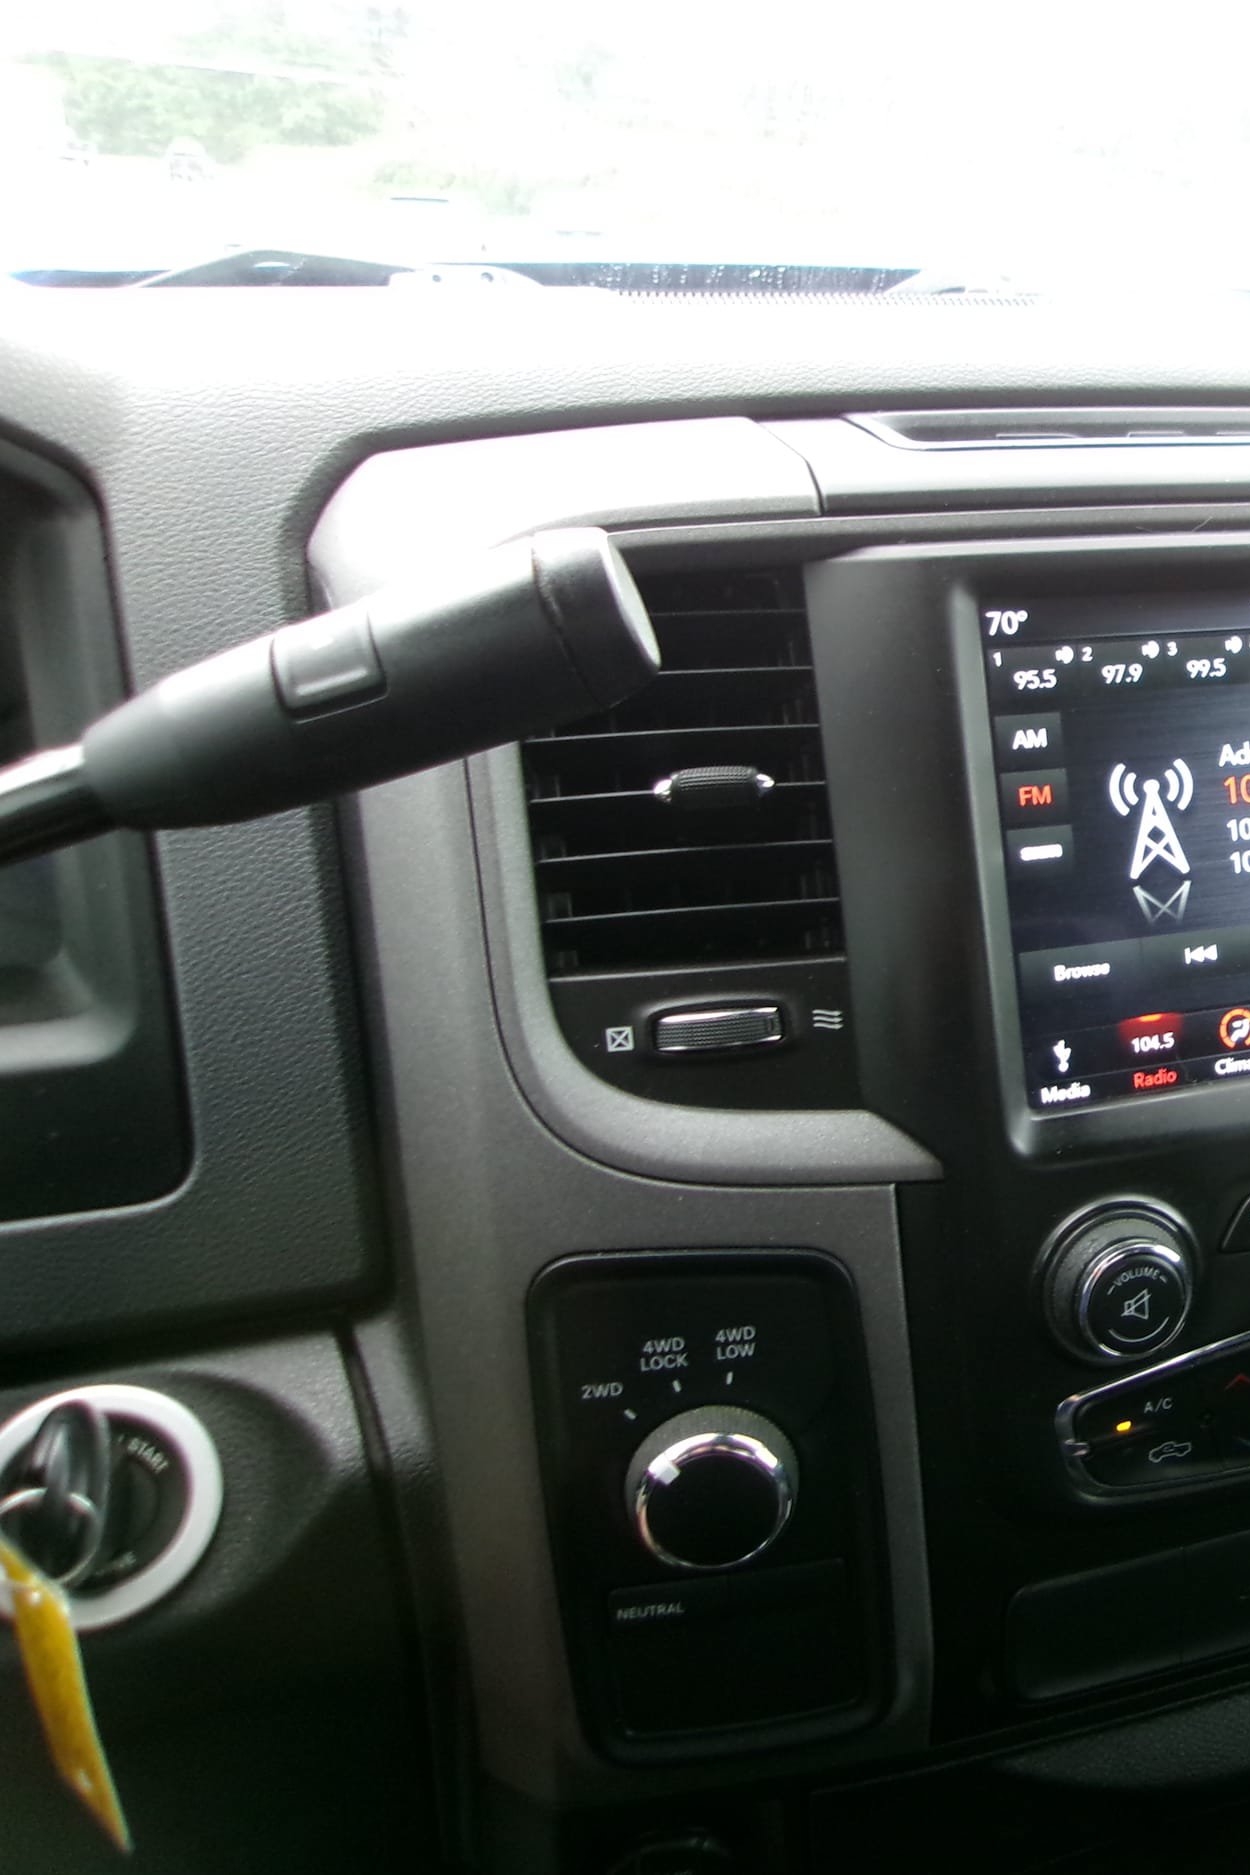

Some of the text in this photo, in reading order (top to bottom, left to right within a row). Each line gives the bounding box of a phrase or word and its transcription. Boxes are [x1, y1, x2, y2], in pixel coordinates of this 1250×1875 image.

[1081, 646, 1093, 662] 2
[1167, 641, 1178, 656] 3
[993, 652, 1002, 667] 1
[1186, 657, 1227, 679] 99.5
[1013, 668, 1057, 690] 95.5
[1101, 663, 1143, 684] 97.9
[1012, 728, 1048, 750] AM
[1018, 784, 1052, 807] FM
[1054, 962, 1110, 981] Browse
[1131, 1032, 1175, 1053] 104.5
[1133, 1068, 1177, 1089] Radio
[1041, 1082, 1091, 1104] Media
[1113, 1266, 1160, 1287] VOLUME
[715, 1326, 756, 1343] 4WD
[643, 1336, 685, 1354] 4WD
[716, 1343, 756, 1361] LOW
[640, 1353, 688, 1372] LOCK
[581, 1382, 623, 1399] 2WD
[1144, 1397, 1173, 1413] A/C
[616, 1602, 684, 1620] NEUTRAL
